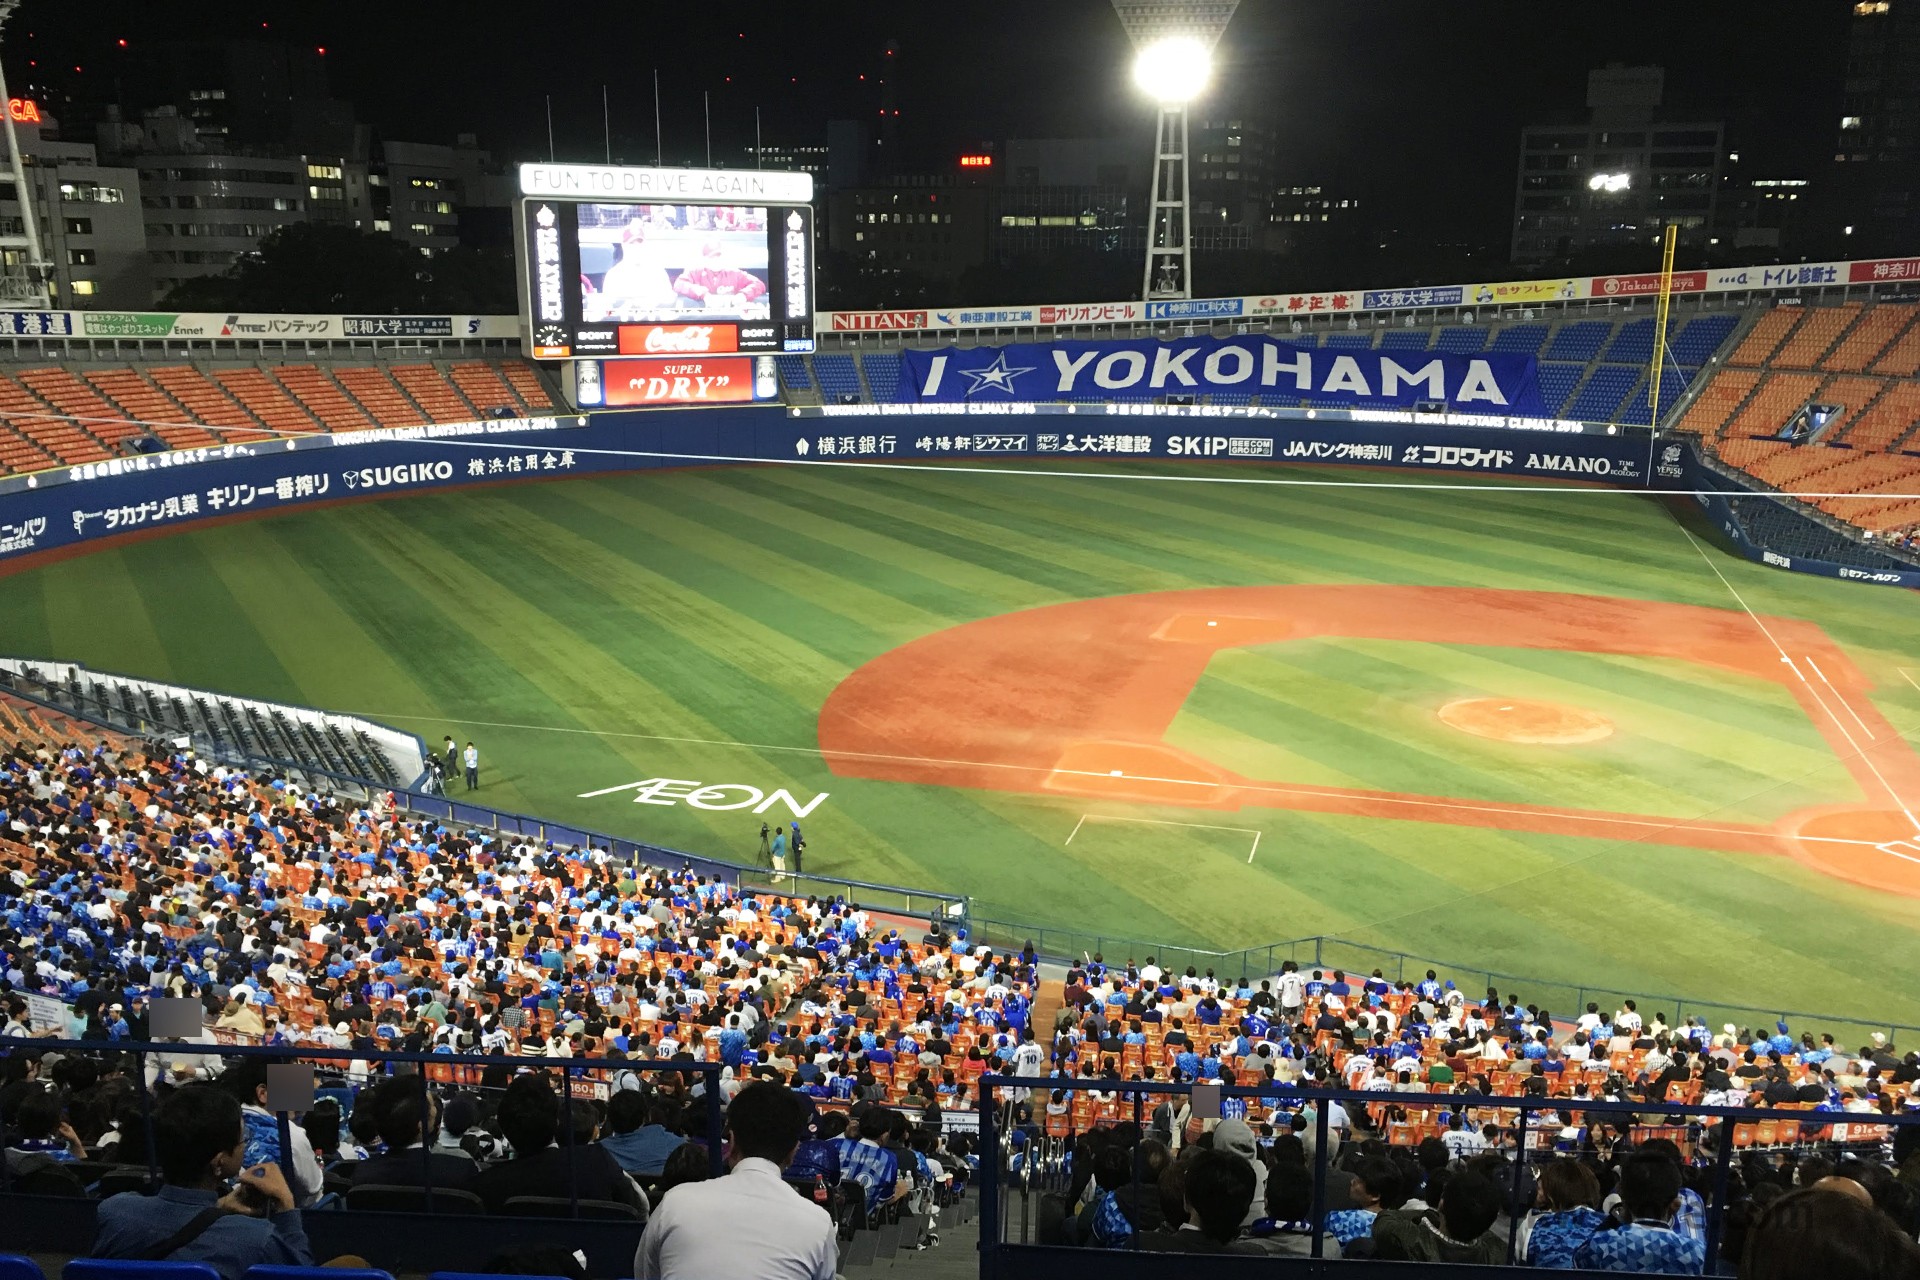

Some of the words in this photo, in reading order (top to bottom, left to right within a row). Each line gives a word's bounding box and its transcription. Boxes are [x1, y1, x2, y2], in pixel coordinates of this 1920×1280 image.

[0, 98, 40, 122] CA
[534, 170, 579, 189] FUN
[588, 171, 614, 190] TO
[702, 175, 765, 195] AGAIN
[1620, 276, 1695, 292] Takashaya
[1763, 266, 1837, 286] トイレ診断士
[1169, 300, 1238, 315] 神奈川工科大学
[1376, 290, 1433, 307] 文教大学
[833, 313, 908, 330] NITTAN
[1056, 305, 1136, 322] オリオンビール
[174, 326, 203, 335] Ennet
[267, 320, 329, 333] バンテック
[344, 319, 402, 335] 昭和大学
[577, 331, 614, 341] SONY
[741, 329, 775, 338] SONY
[662, 364, 703, 375] SUPER
[921, 356, 948, 396] I
[1050, 344, 1510, 406] YOKOHAMA
[821, 404, 879, 416] YOKOHAMA
[912, 404, 966, 415] BAYSTARS
[968, 404, 1010, 415] CLIMAX
[1351, 410, 1412, 424] YOKOHAMA
[1448, 415, 1506, 429] BAYSTARS
[1509, 418, 1554, 432] CLIMAX
[331, 428, 393, 446] YOKOHAMA
[428, 422, 484, 438] BAYSTARS
[487, 418, 530, 433] CLIMAX
[817, 435, 897, 456] 横浜銀行
[915, 436, 972, 452] 崎陽軒
[974, 435, 1027, 451] シウマイ
[1037, 442, 1059, 451] グループ
[1080, 434, 1152, 453] 大洋建設
[1167, 436, 1228, 456] SKiP
[1231, 447, 1263, 455] GROUP
[1283, 441, 1393, 462] JAバンク神奈川
[467, 451, 577, 477] 横浜信用金庫
[1422, 445, 1515, 468] コロワイド
[1525, 453, 1611, 475] AMANO
[1618, 459, 1635, 468] TIME
[360, 460, 454, 488] SUGIKO
[206, 472, 330, 510] キリン一番搾り
[104, 493, 200, 529] タカナシ乳業
[1, 516, 46, 544] ニッパツ
[1025, 1055, 1037, 1065] 10
